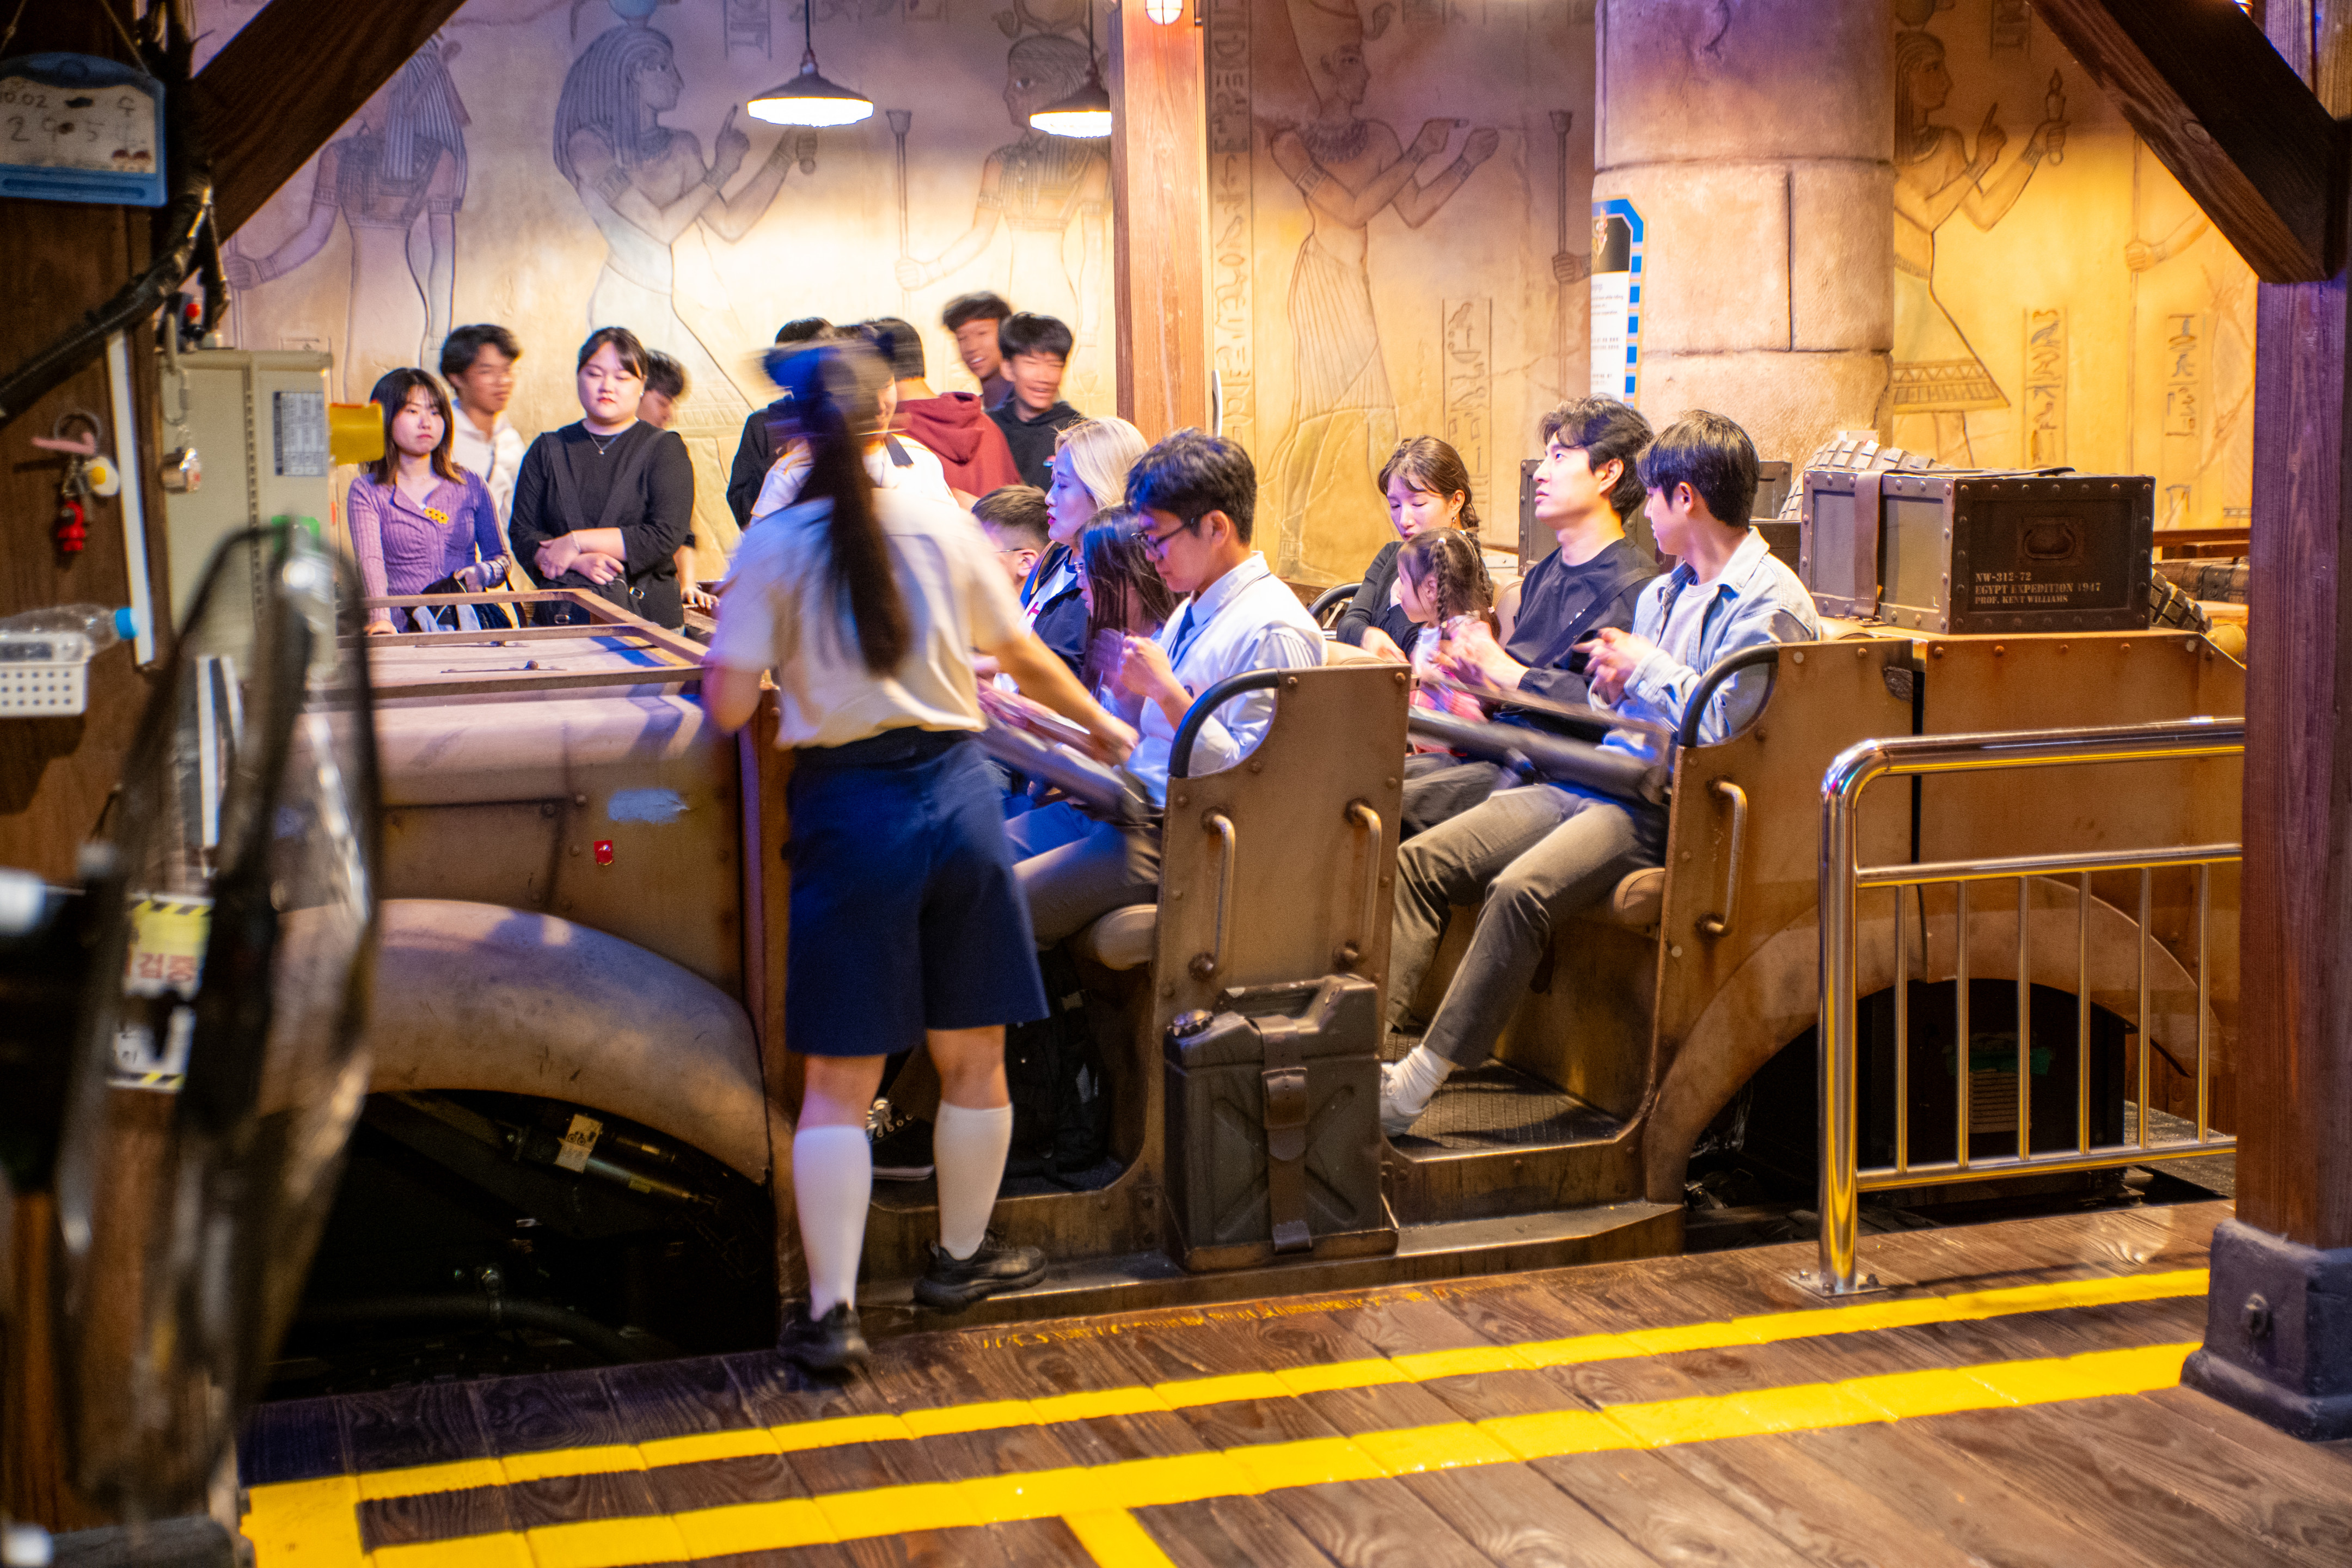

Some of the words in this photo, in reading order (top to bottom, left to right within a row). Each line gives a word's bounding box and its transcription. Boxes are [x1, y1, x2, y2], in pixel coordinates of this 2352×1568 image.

[1975, 572, 2032, 583] NW-312-72
[1975, 584, 2008, 595] EGYPT
[2011, 583, 2073, 594] EXPEDITION
[1975, 596, 2000, 604] PROF.
[2002, 596, 2025, 604] KENT
[2027, 595, 2068, 603] WILLIAMS
